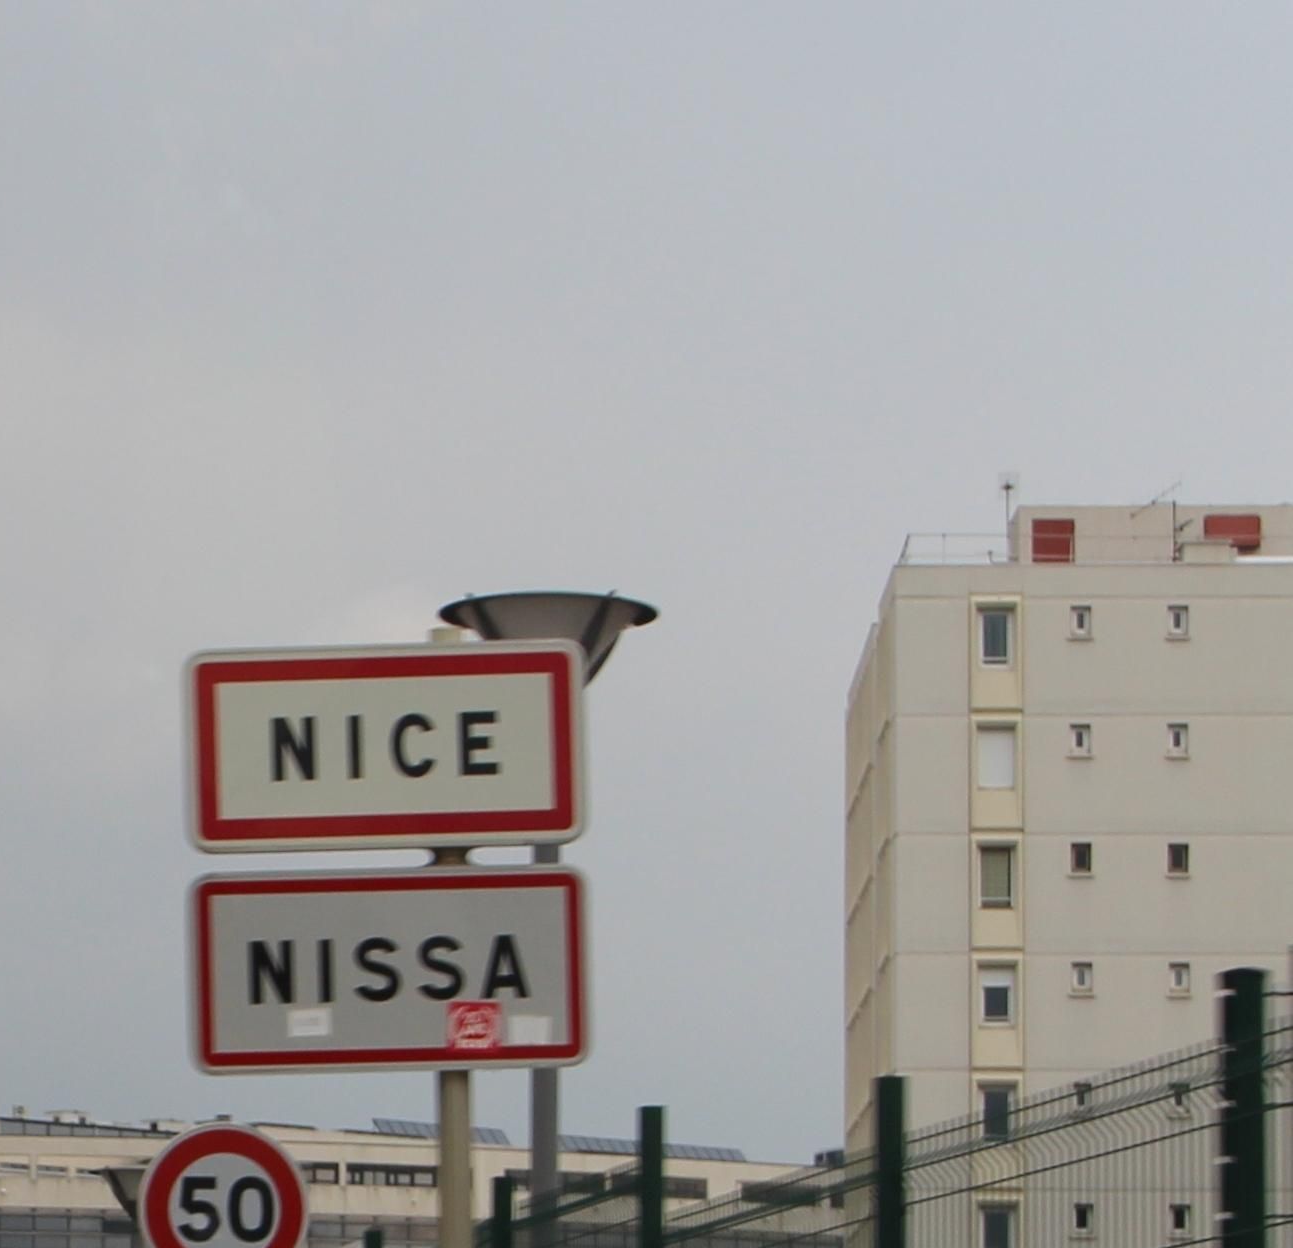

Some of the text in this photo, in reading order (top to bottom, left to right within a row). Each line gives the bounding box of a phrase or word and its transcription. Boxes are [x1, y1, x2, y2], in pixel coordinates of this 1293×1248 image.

[270, 711, 502, 782] NICE
[247, 934, 532, 1005] NISSA
[177, 1175, 274, 1243] 50
